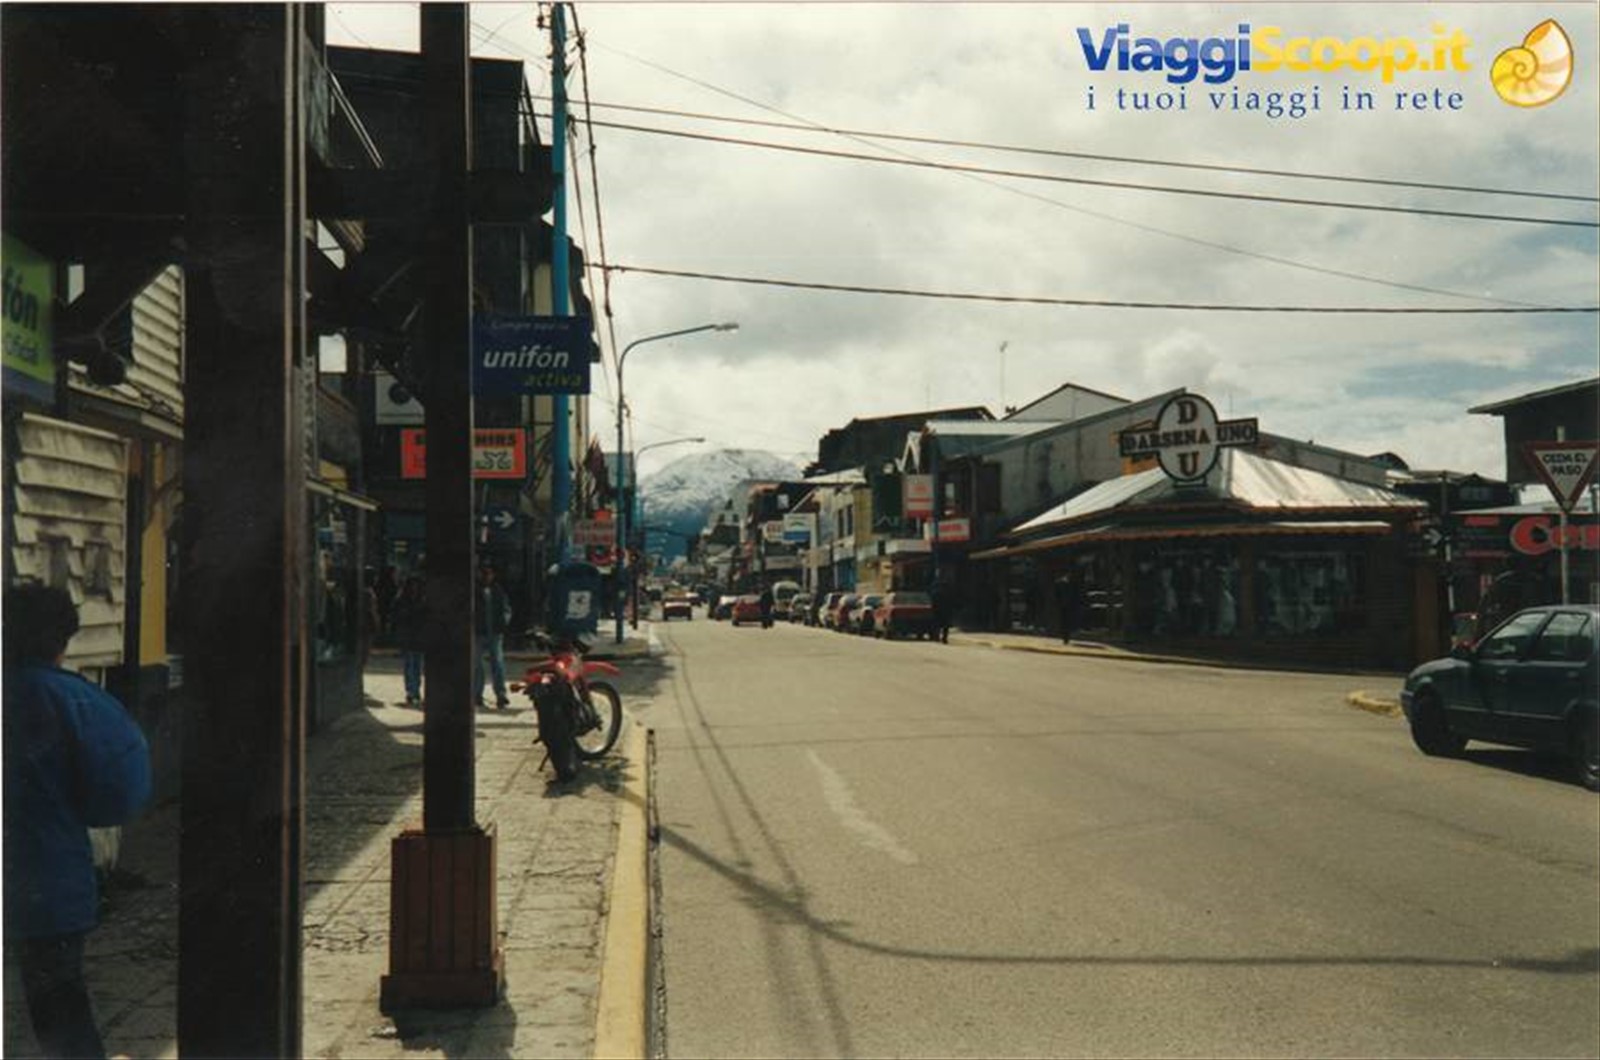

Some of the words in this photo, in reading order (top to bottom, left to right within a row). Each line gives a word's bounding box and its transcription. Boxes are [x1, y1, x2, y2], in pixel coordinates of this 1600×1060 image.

[483, 345, 569, 368] unifón
[1217, 425, 1254, 442] UNO
[1551, 464, 1582, 476] PASO
